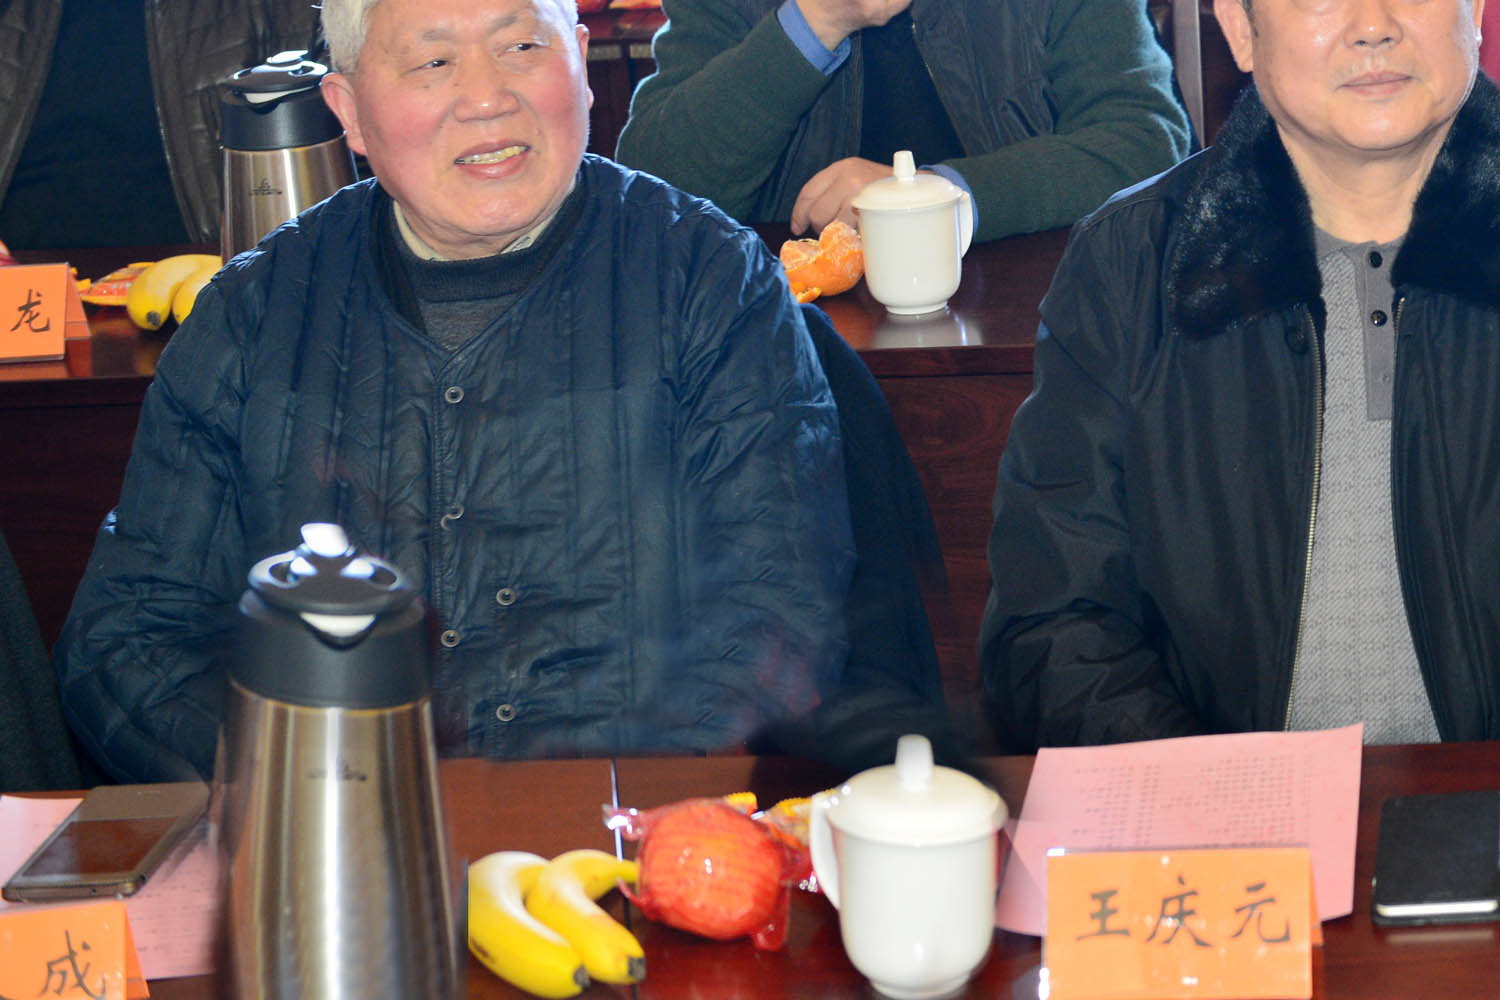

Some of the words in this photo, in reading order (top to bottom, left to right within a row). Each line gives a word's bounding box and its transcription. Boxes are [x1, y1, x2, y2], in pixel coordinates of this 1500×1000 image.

[10, 289, 50, 333] 龙
[1075, 874, 1292, 947] 王庆元
[38, 930, 107, 1000] 成
